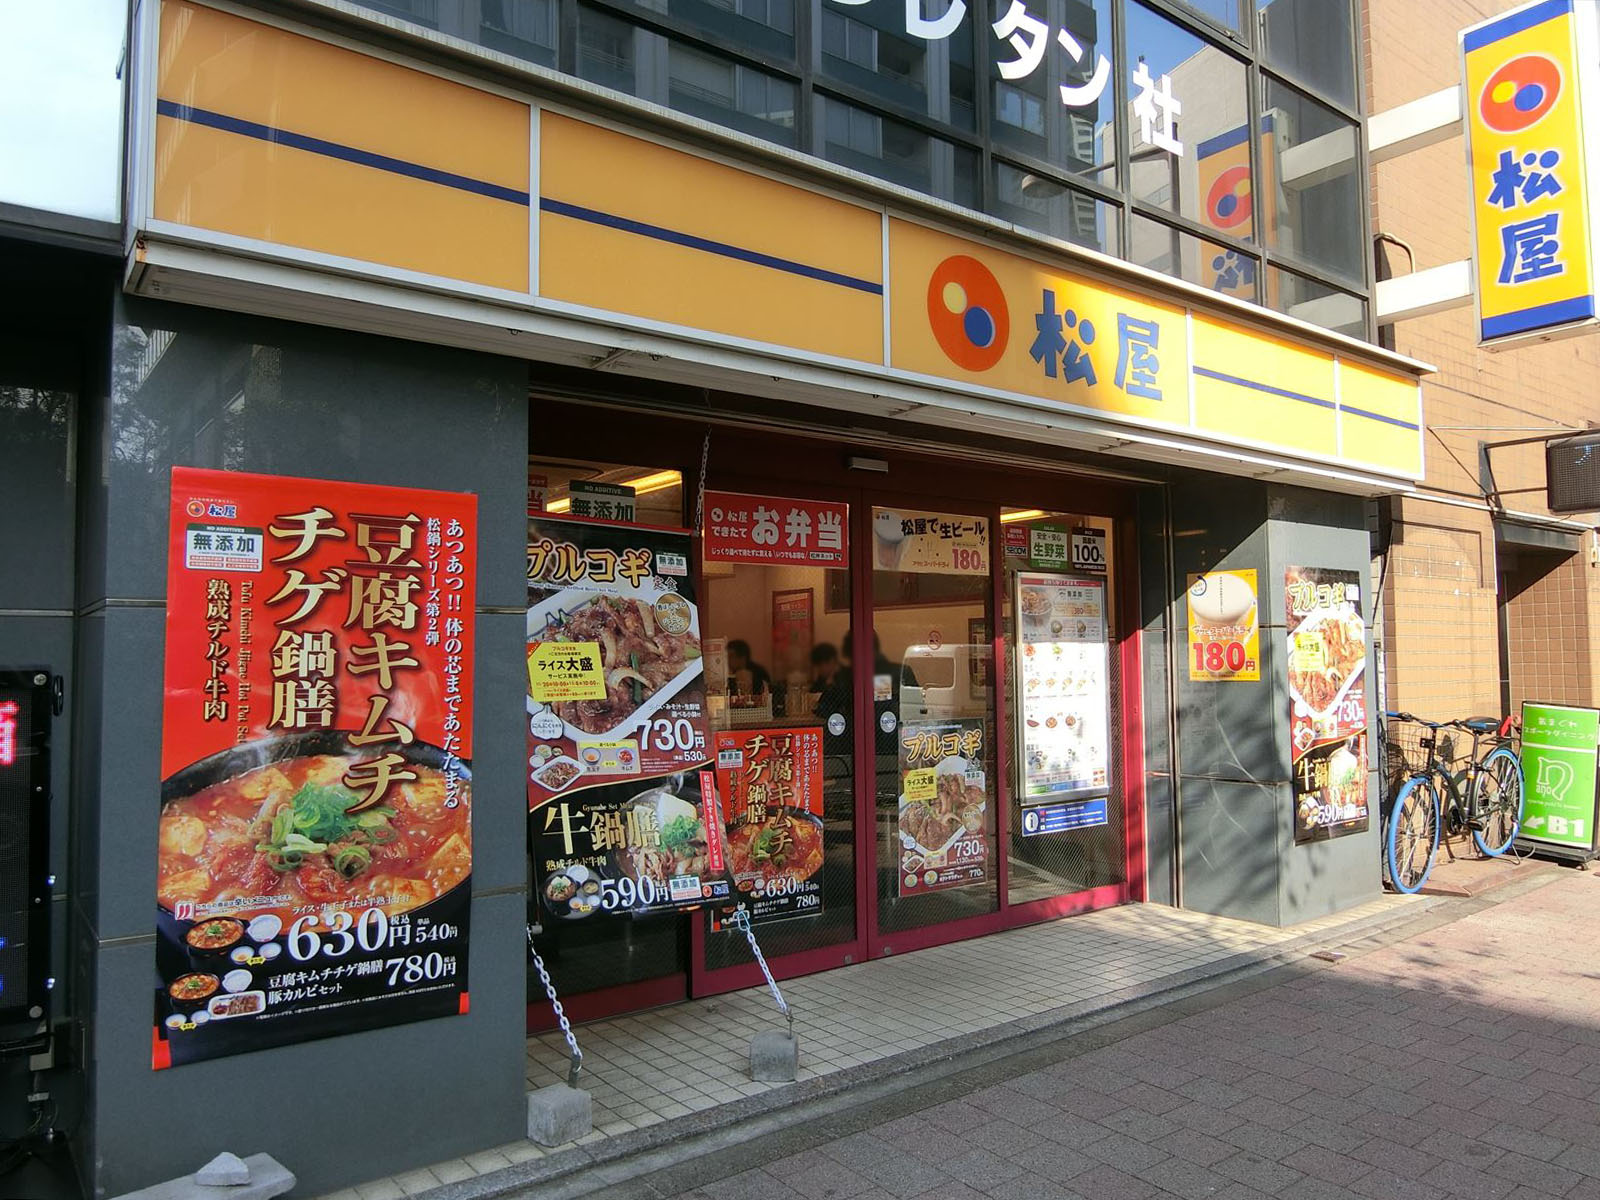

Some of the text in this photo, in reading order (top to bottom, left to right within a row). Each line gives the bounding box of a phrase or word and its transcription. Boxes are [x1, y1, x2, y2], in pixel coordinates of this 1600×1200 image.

[1487, 149, 1564, 284] 松屋
[1029, 289, 1163, 402] 松屋
[208, 504, 237, 519] 松屋
[571, 497, 633, 522] 無添加
[727, 510, 748, 523] 松屋
[193, 532, 255, 553] 無添加
[711, 526, 748, 538] できたて
[751, 505, 842, 550] お弁当
[528, 541, 650, 588] プルコギ
[1006, 546, 1027, 555] SECOM
[1033, 542, 1065, 559] 生野菜
[426, 517, 441, 647] 松鍋シリーズ第2弾
[267, 507, 346, 729] チゲ鍋膳
[203, 578, 231, 722] 熟成チルド牛肉
[344, 512, 424, 813] 豆腐キムチ
[538, 656, 593, 671] ライス大盛
[902, 730, 982, 762] プルコギ
[744, 734, 770, 824] チゲ鍋膳
[769, 732, 794, 855] 豆腐キムチ
[542, 803, 661, 855] 牛鍋膳
[1547, 815, 1585, 838] B1
[546, 855, 607, 872] 熟成チルド牛肉
[268, 959, 384, 989] 豆腐キムチチゲ鍋膳
[268, 982, 343, 1005] 豚カルビセット
